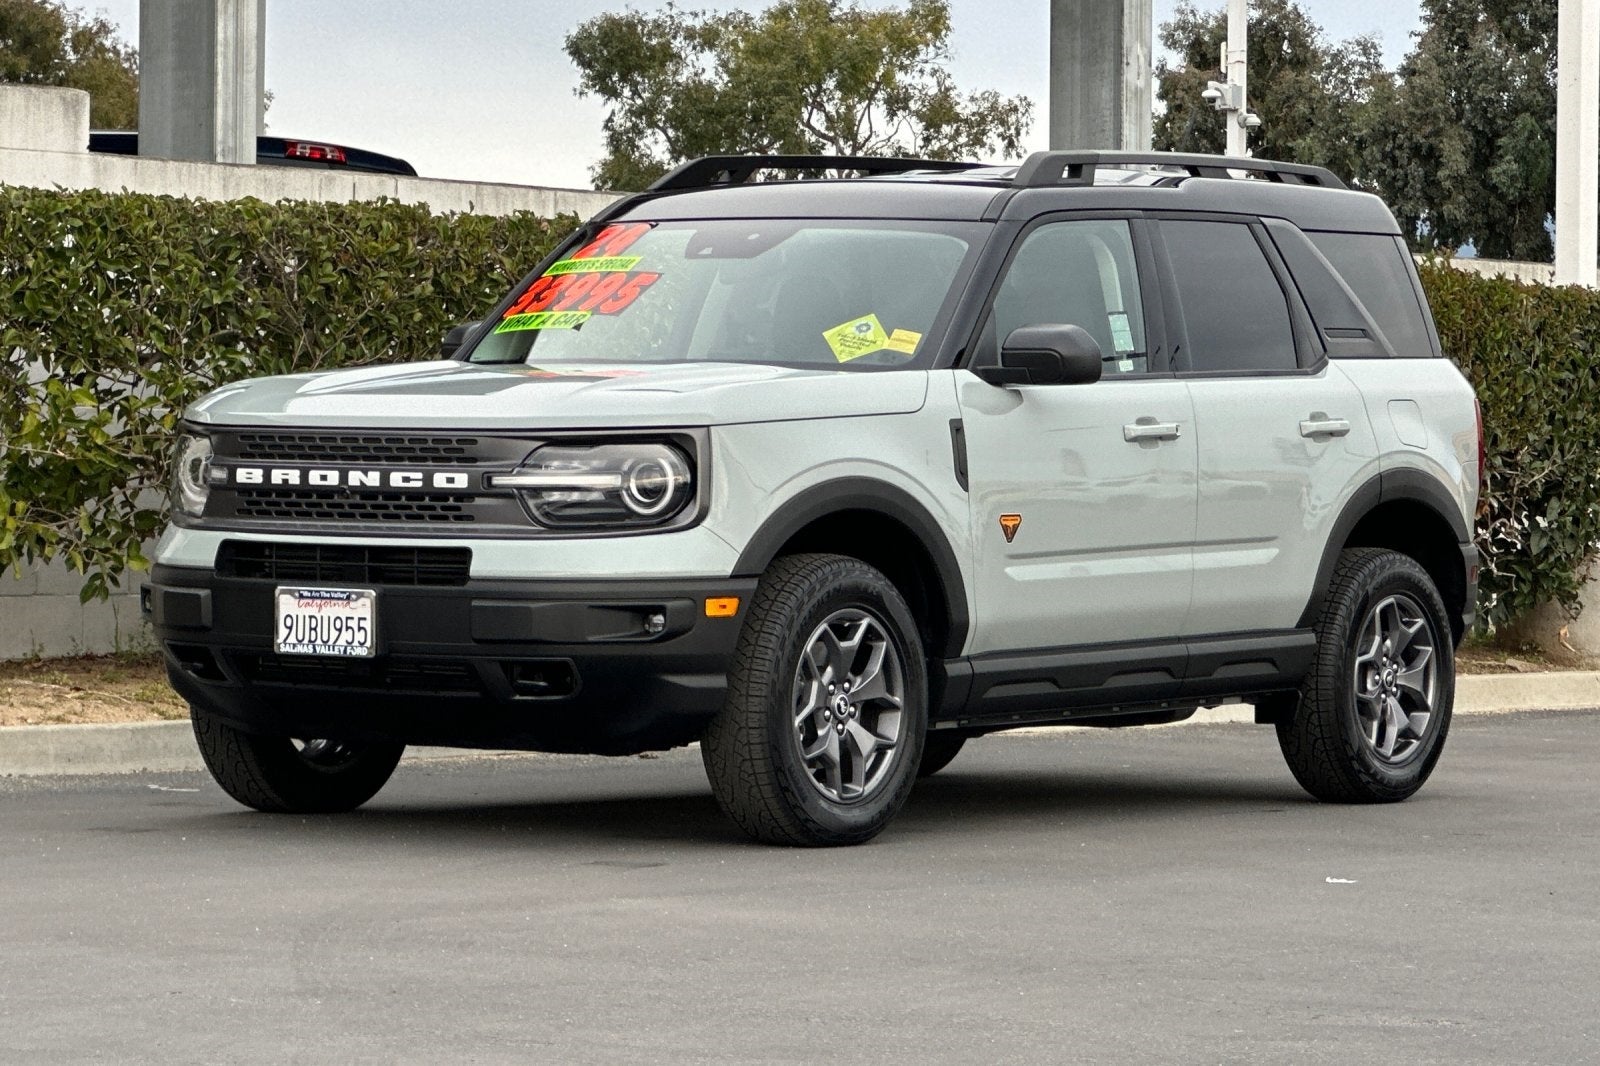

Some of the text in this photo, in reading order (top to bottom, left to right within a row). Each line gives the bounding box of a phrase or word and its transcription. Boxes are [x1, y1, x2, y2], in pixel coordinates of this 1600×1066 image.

[595, 258, 637, 270] SPECIAL
[503, 272, 659, 318] 33995
[500, 312, 586, 331] WHAT A CAR
[236, 467, 468, 488] BRONCO
[297, 599, 357, 613] California
[282, 613, 368, 646] 9UBU955
[315, 644, 345, 655] VALLEY
[346, 645, 368, 656] FORD
